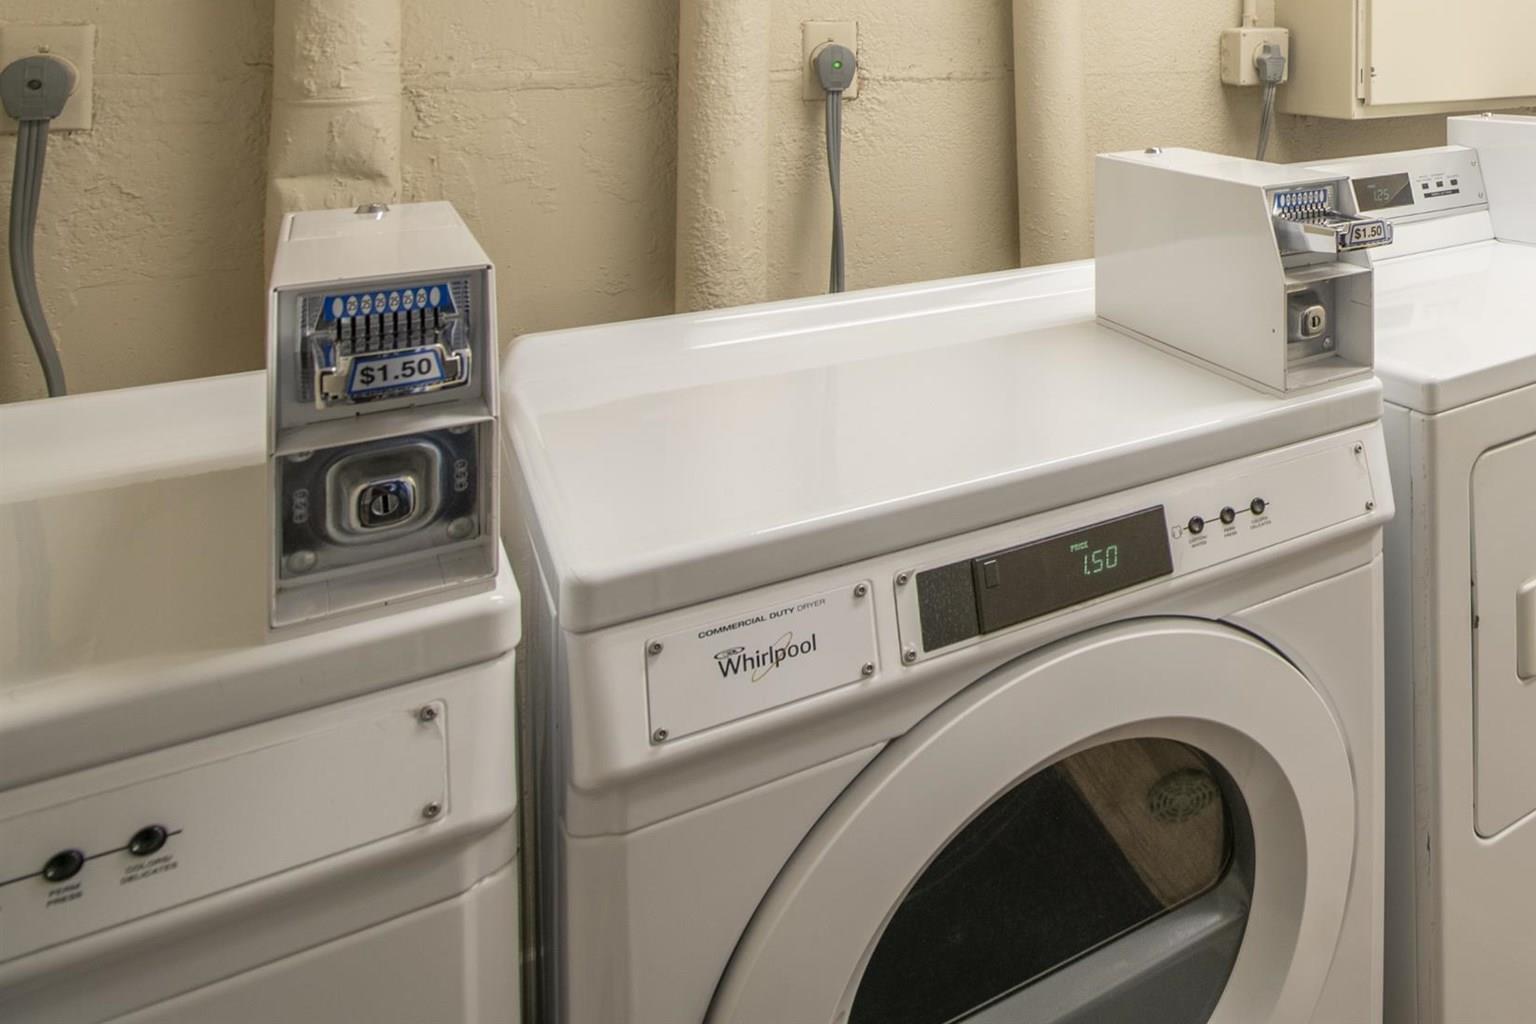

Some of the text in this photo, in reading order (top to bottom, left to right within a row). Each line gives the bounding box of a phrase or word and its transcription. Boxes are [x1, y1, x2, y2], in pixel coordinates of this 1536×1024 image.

[1354, 225, 1383, 240] $1.50
[360, 358, 432, 386] $1.50
[1084, 544, 1118, 575] 1.50
[698, 597, 827, 639] COMMERCIAL DUTY DRYER
[717, 633, 817, 678] Whirlpool
